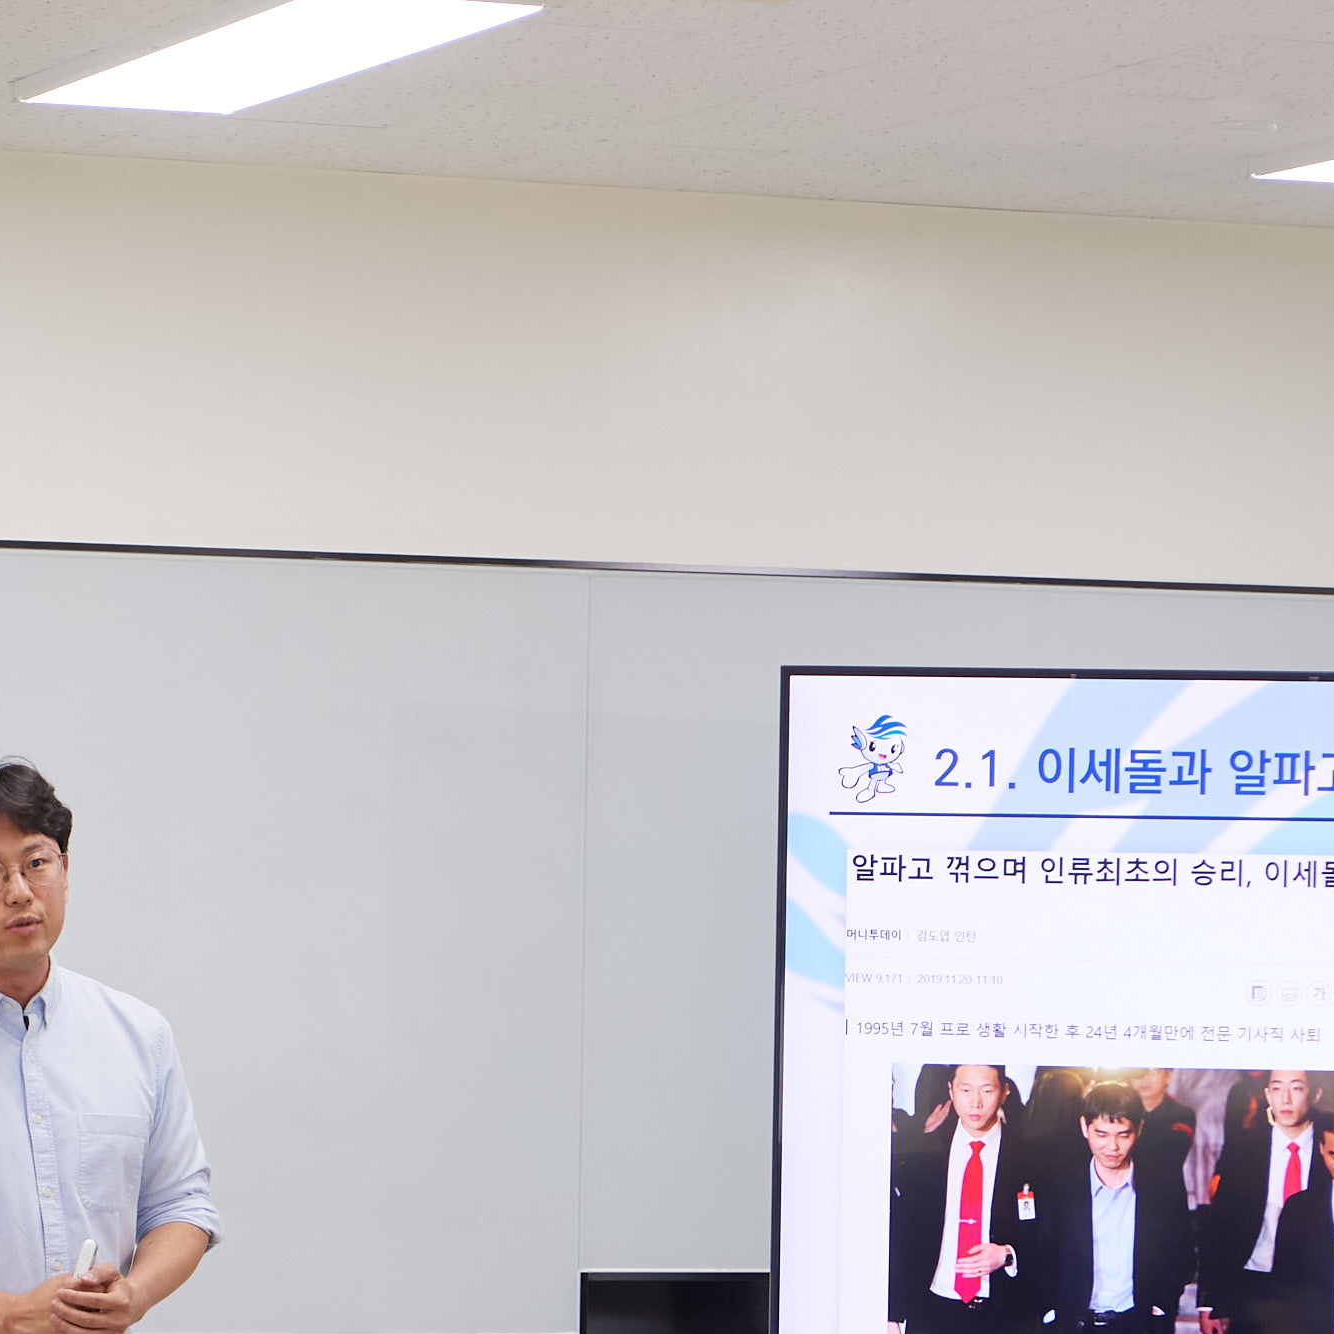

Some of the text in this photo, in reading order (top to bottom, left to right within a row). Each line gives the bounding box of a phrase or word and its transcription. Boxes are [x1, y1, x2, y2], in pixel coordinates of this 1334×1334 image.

[934, 747, 1016, 790] 2.1.
[1038, 747, 1213, 796] 이세돌과
[852, 853, 934, 883] 알파고
[946, 855, 1026, 885] 꺾으며
[1040, 856, 1177, 887] 인류최초의
[1190, 858, 1252, 889] 승리,
[846, 928, 902, 942] 머니투데이
[845, 972, 873, 983] VIEW
[857, 1020, 1321, 1044] 1995년 7월 프로 생활 시작한 후 24년 4개월만에 전문 기사직 사퇴
